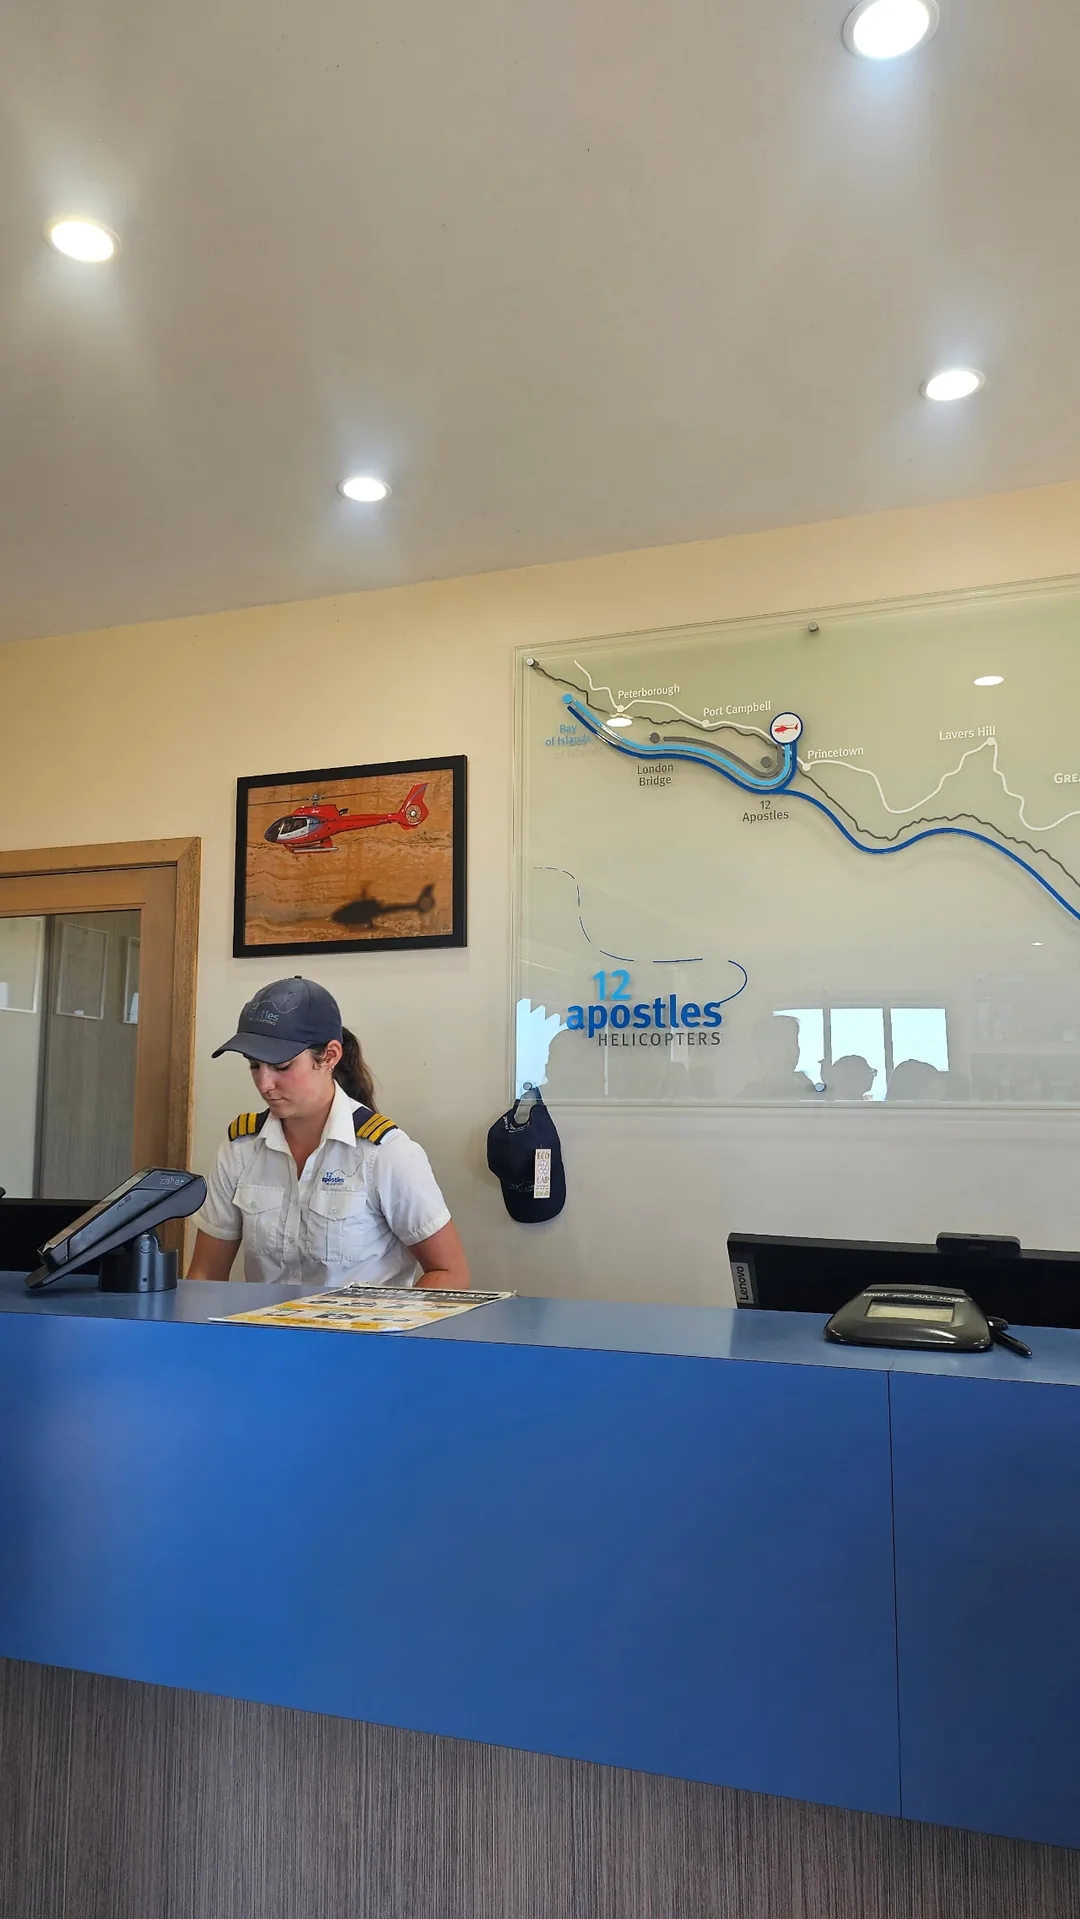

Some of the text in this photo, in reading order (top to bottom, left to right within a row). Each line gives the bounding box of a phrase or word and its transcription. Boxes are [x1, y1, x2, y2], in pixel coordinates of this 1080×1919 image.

[618, 684, 680, 700] Peterborough
[703, 701, 771, 717] Port Campbell
[560, 725, 577, 735] Bay
[939, 725, 996, 741] Lavers Hill
[546, 737, 554, 746] of
[807, 747, 864, 760] Princetown
[637, 763, 674, 775] London
[639, 775, 672, 788] Bridge
[760, 801, 771, 810] 12
[742, 810, 789, 823] Apostles
[592, 969, 632, 1001] 12
[566, 994, 722, 1038] apostles
[598, 1032, 721, 1047] HELICOPTERS
[736, 1265, 749, 1301] Lenovo
